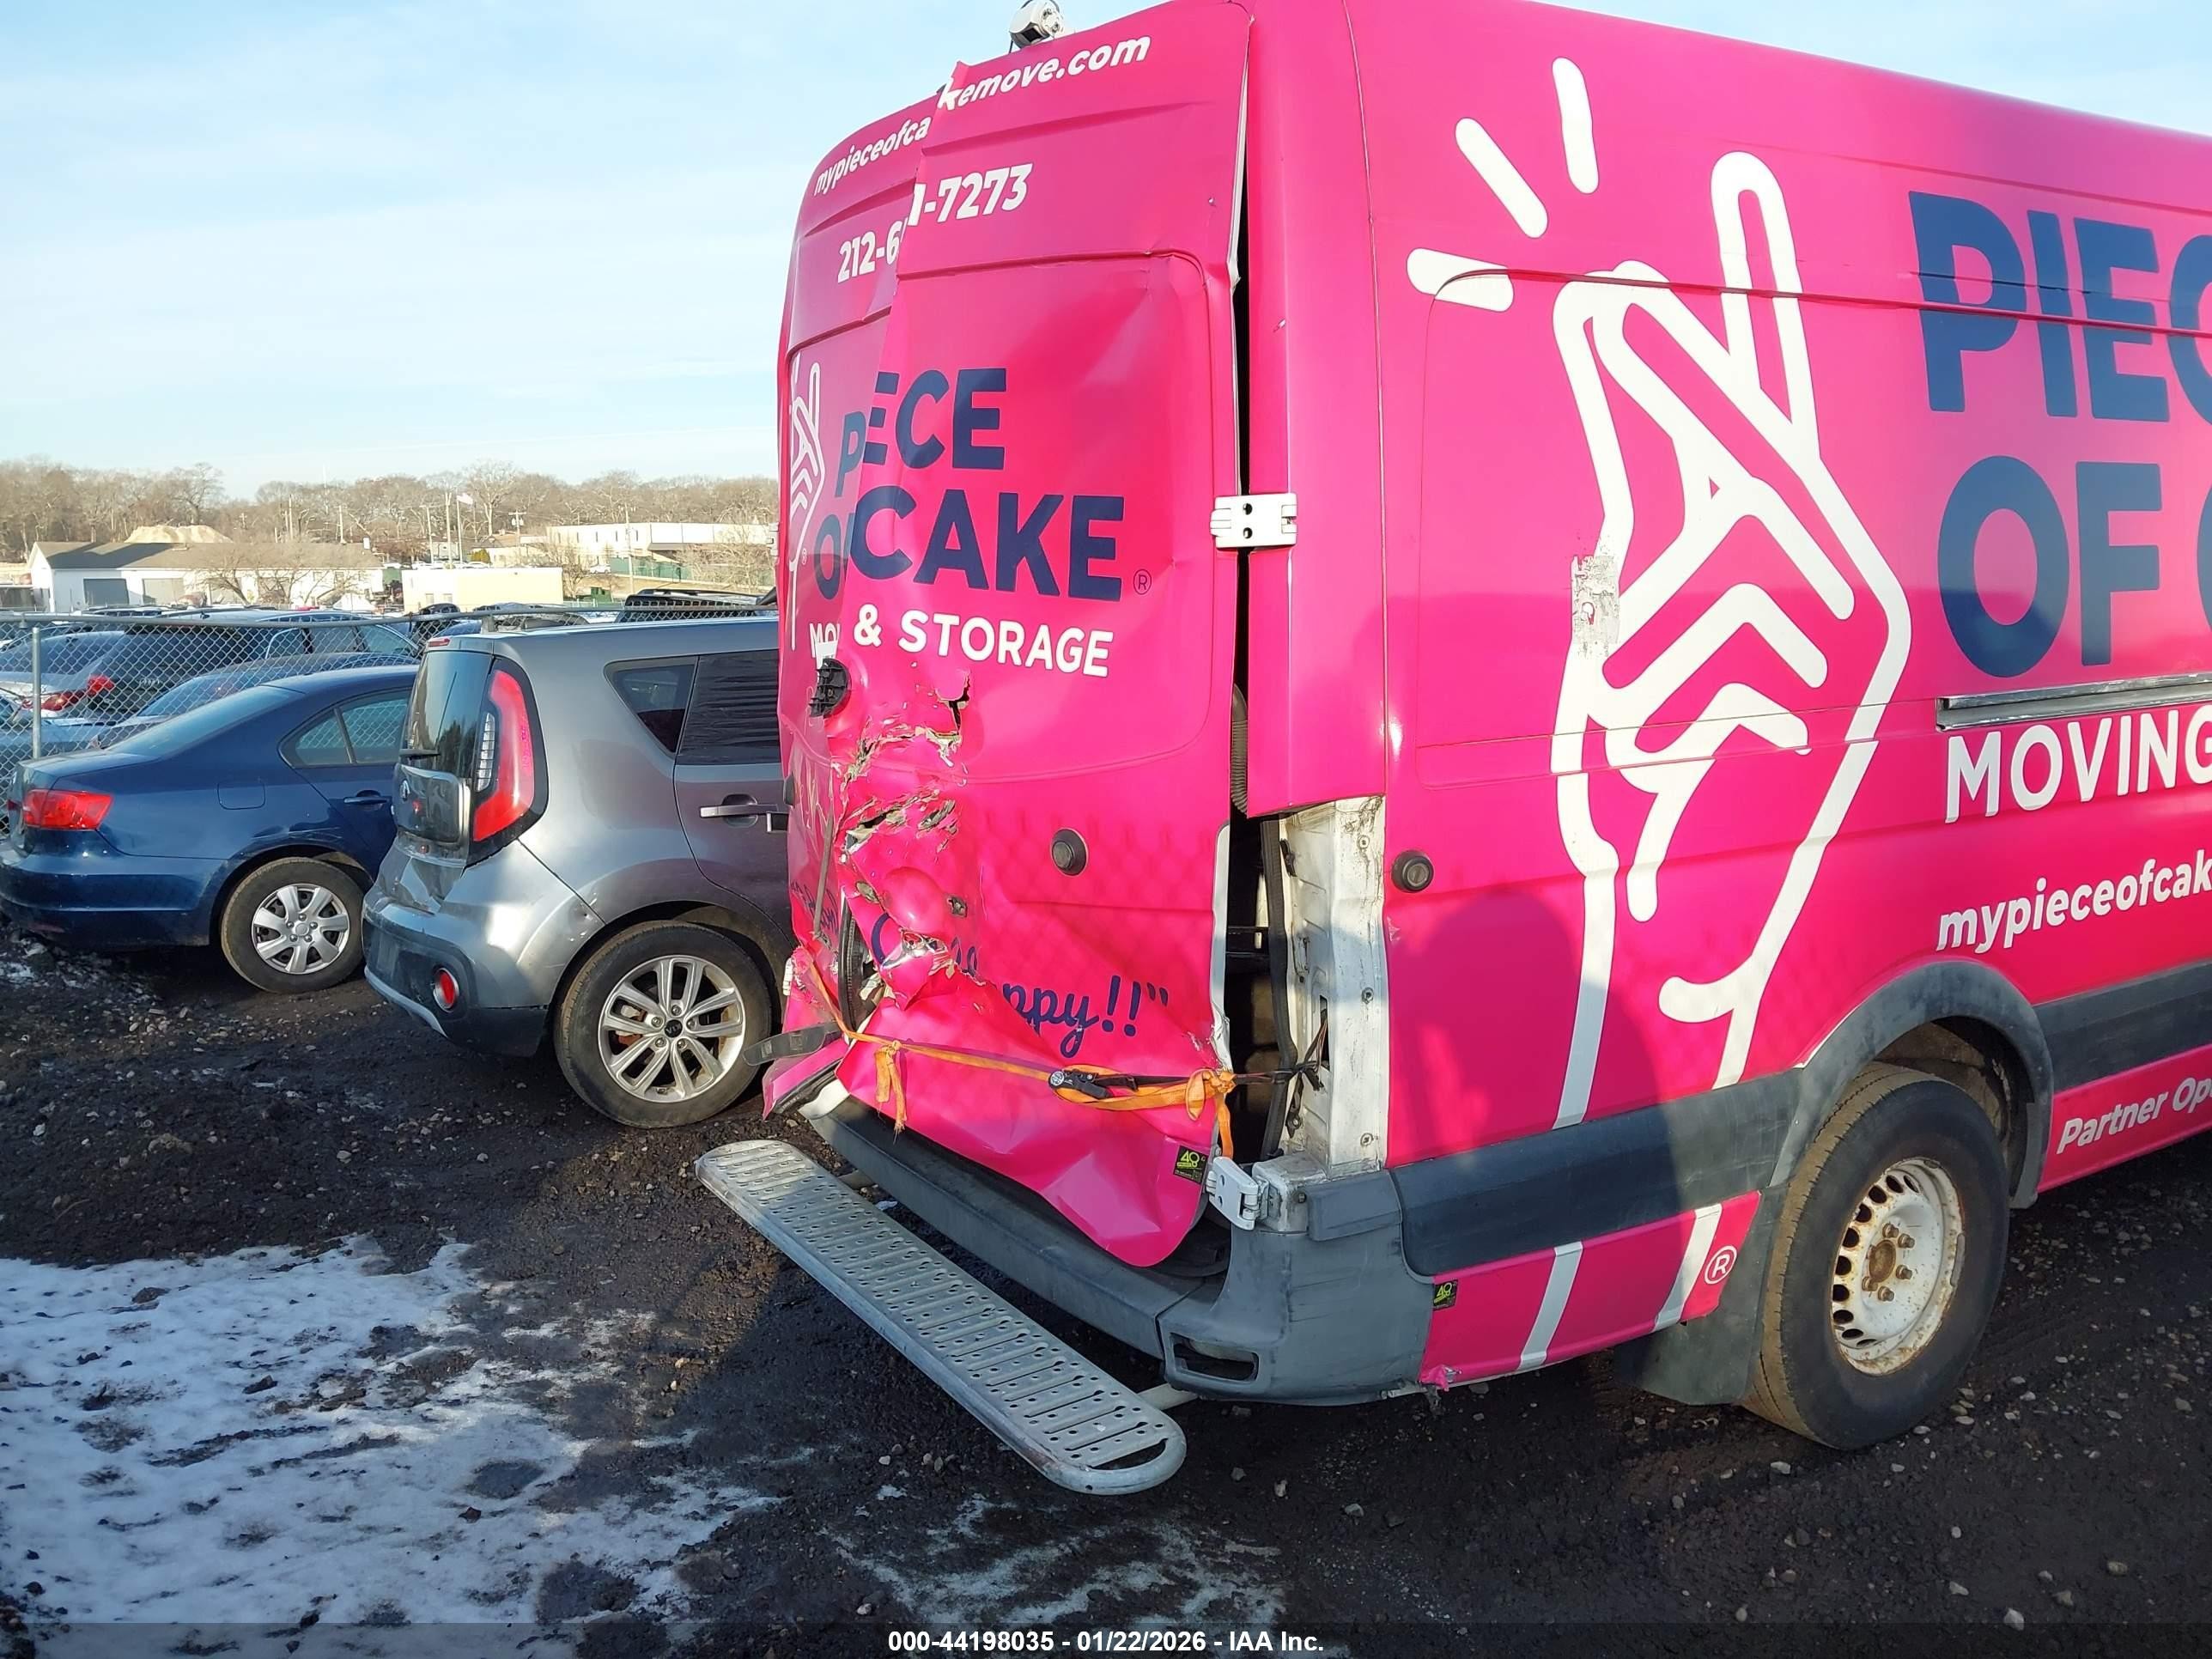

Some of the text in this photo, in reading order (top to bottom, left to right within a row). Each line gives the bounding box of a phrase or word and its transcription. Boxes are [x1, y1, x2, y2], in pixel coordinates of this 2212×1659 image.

[849, 485, 1124, 600] CAKE
[1937, 455, 2161, 678] OF
[854, 604, 883, 647] &
[898, 609, 1115, 678] STORAGE
[2056, 1076, 2212, 1155] Partner Op
